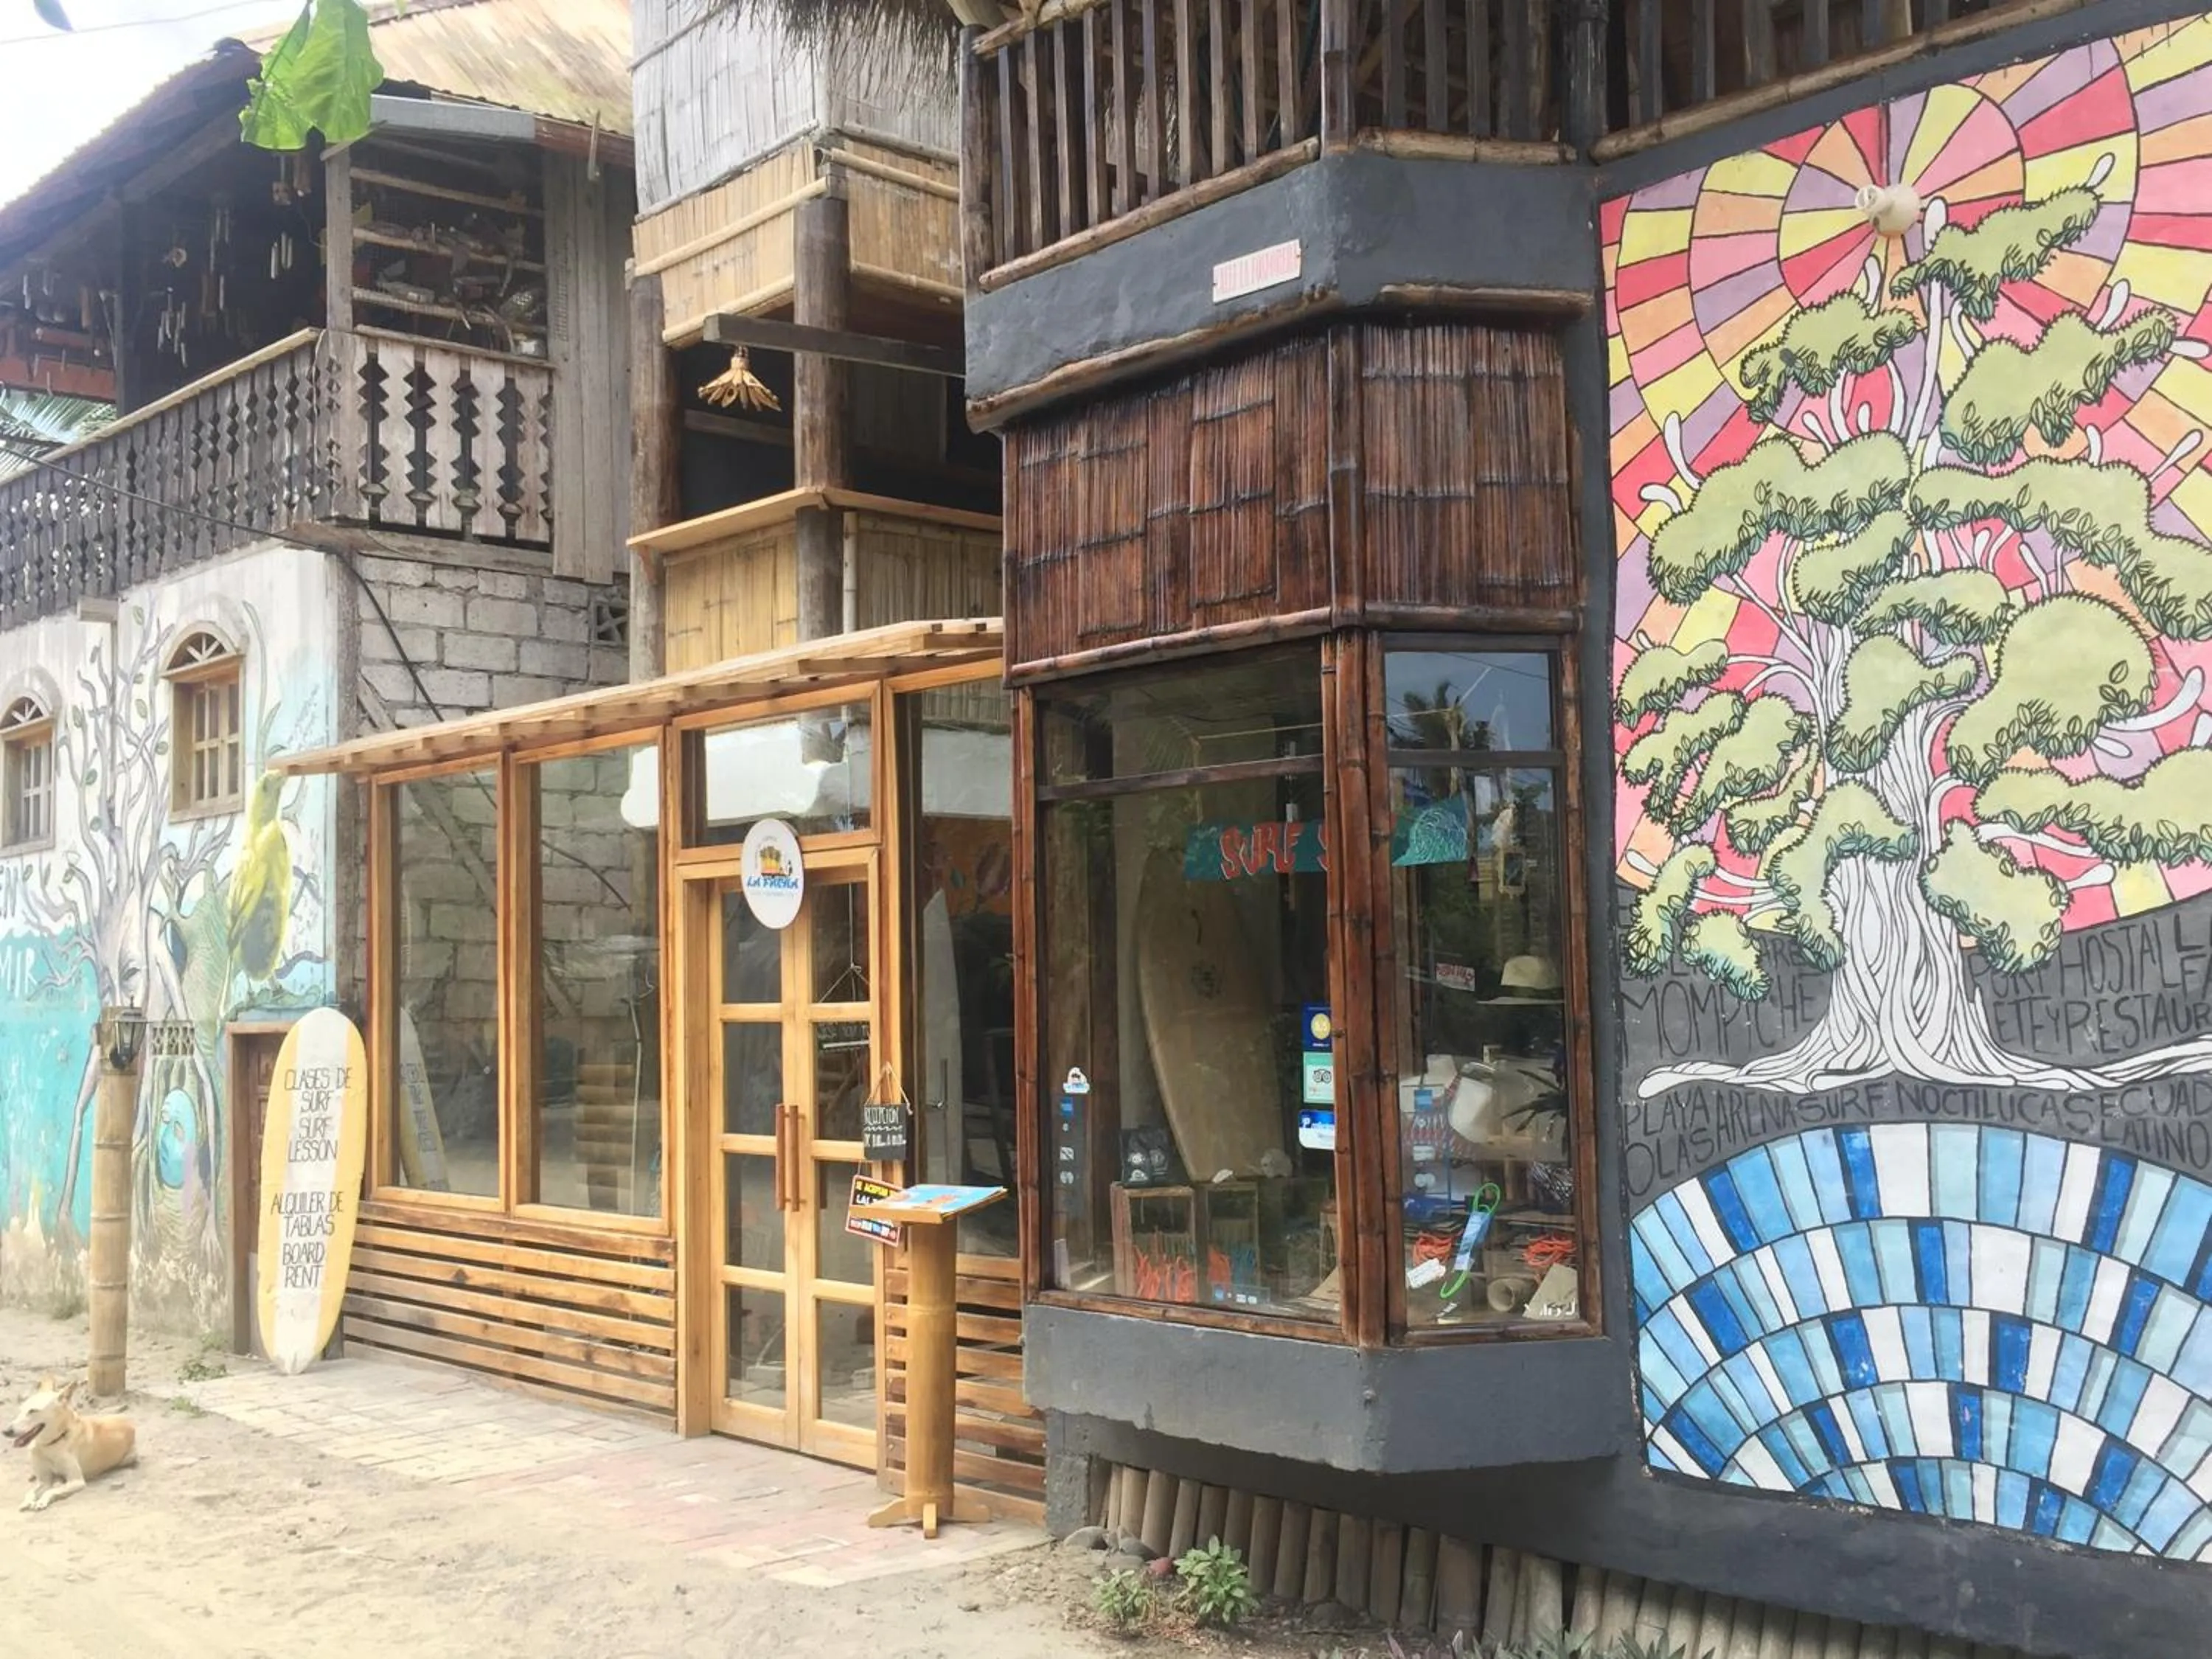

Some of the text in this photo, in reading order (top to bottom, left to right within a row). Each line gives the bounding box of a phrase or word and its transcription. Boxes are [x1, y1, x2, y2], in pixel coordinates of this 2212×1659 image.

[1220, 822, 1304, 880] SURF
[2059, 919, 2180, 997] HOSTAL
[1620, 974, 1823, 1068] MOMPICHE
[284, 1067, 353, 1091] CLASES DE
[300, 1090, 335, 1113] SURF
[299, 1116, 333, 1139] SURF
[1624, 1086, 1711, 1144] PLAYA
[1716, 1089, 1798, 1151] ARENA
[1796, 1082, 1888, 1122] SURF
[288, 1139, 338, 1163] LESSON
[2101, 1117, 2210, 1170] LATINO
[1624, 1127, 1715, 1197] OLAS
[271, 1191, 344, 1216] ALQUILER DE
[283, 1214, 335, 1239] TABLAS
[282, 1242, 325, 1265] BOARD
[284, 1265, 324, 1288] RENT
